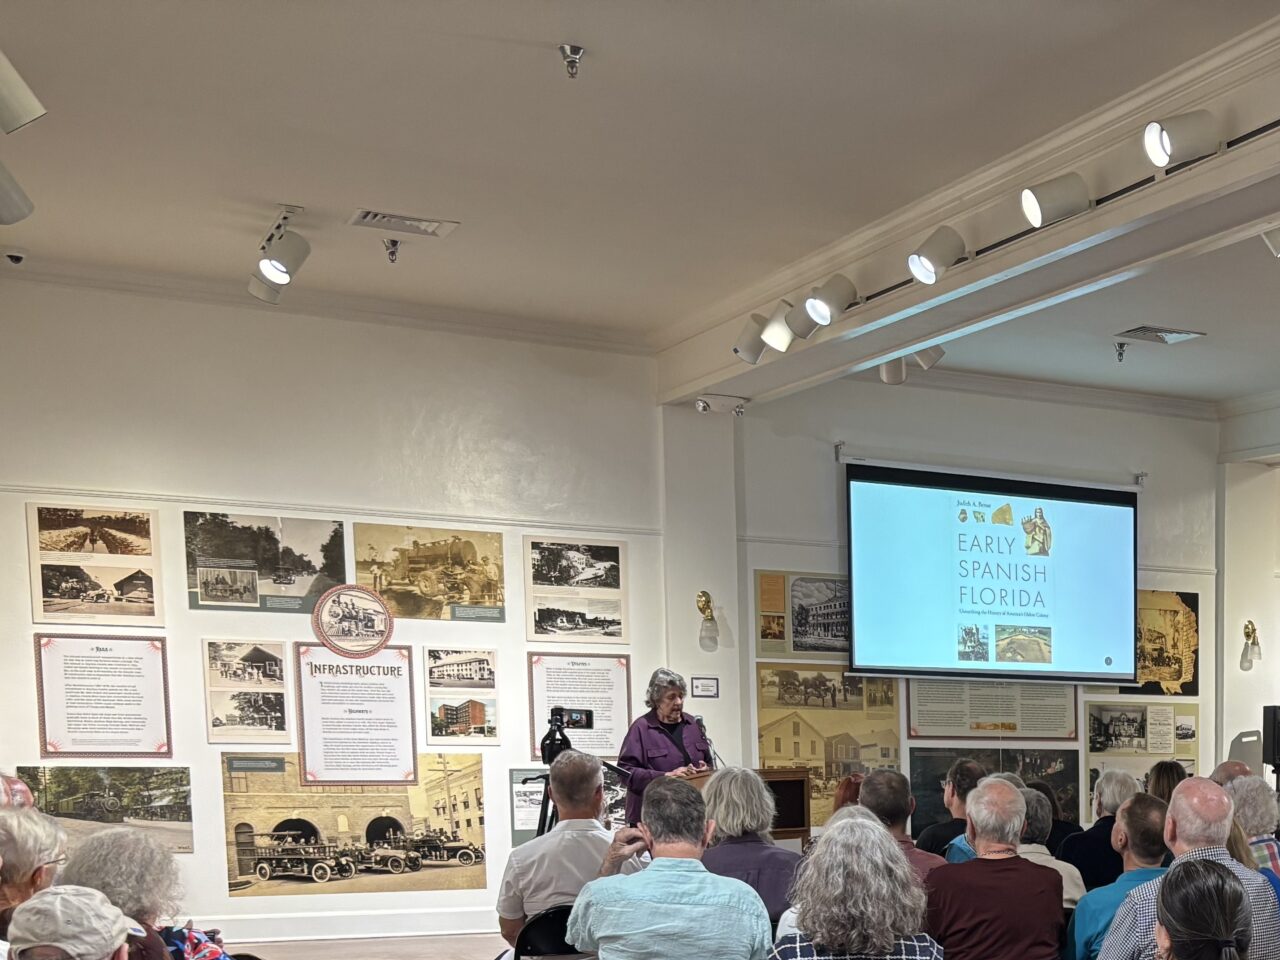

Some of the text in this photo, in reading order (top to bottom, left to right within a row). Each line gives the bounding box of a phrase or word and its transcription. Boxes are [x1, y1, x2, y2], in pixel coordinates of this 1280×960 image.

[958, 533, 1016, 555] EARLY
[958, 559, 1046, 583] SPANISH
[959, 585, 1046, 608] FLORIDA
[306, 661, 403, 678] INFRASTRUCTURE
